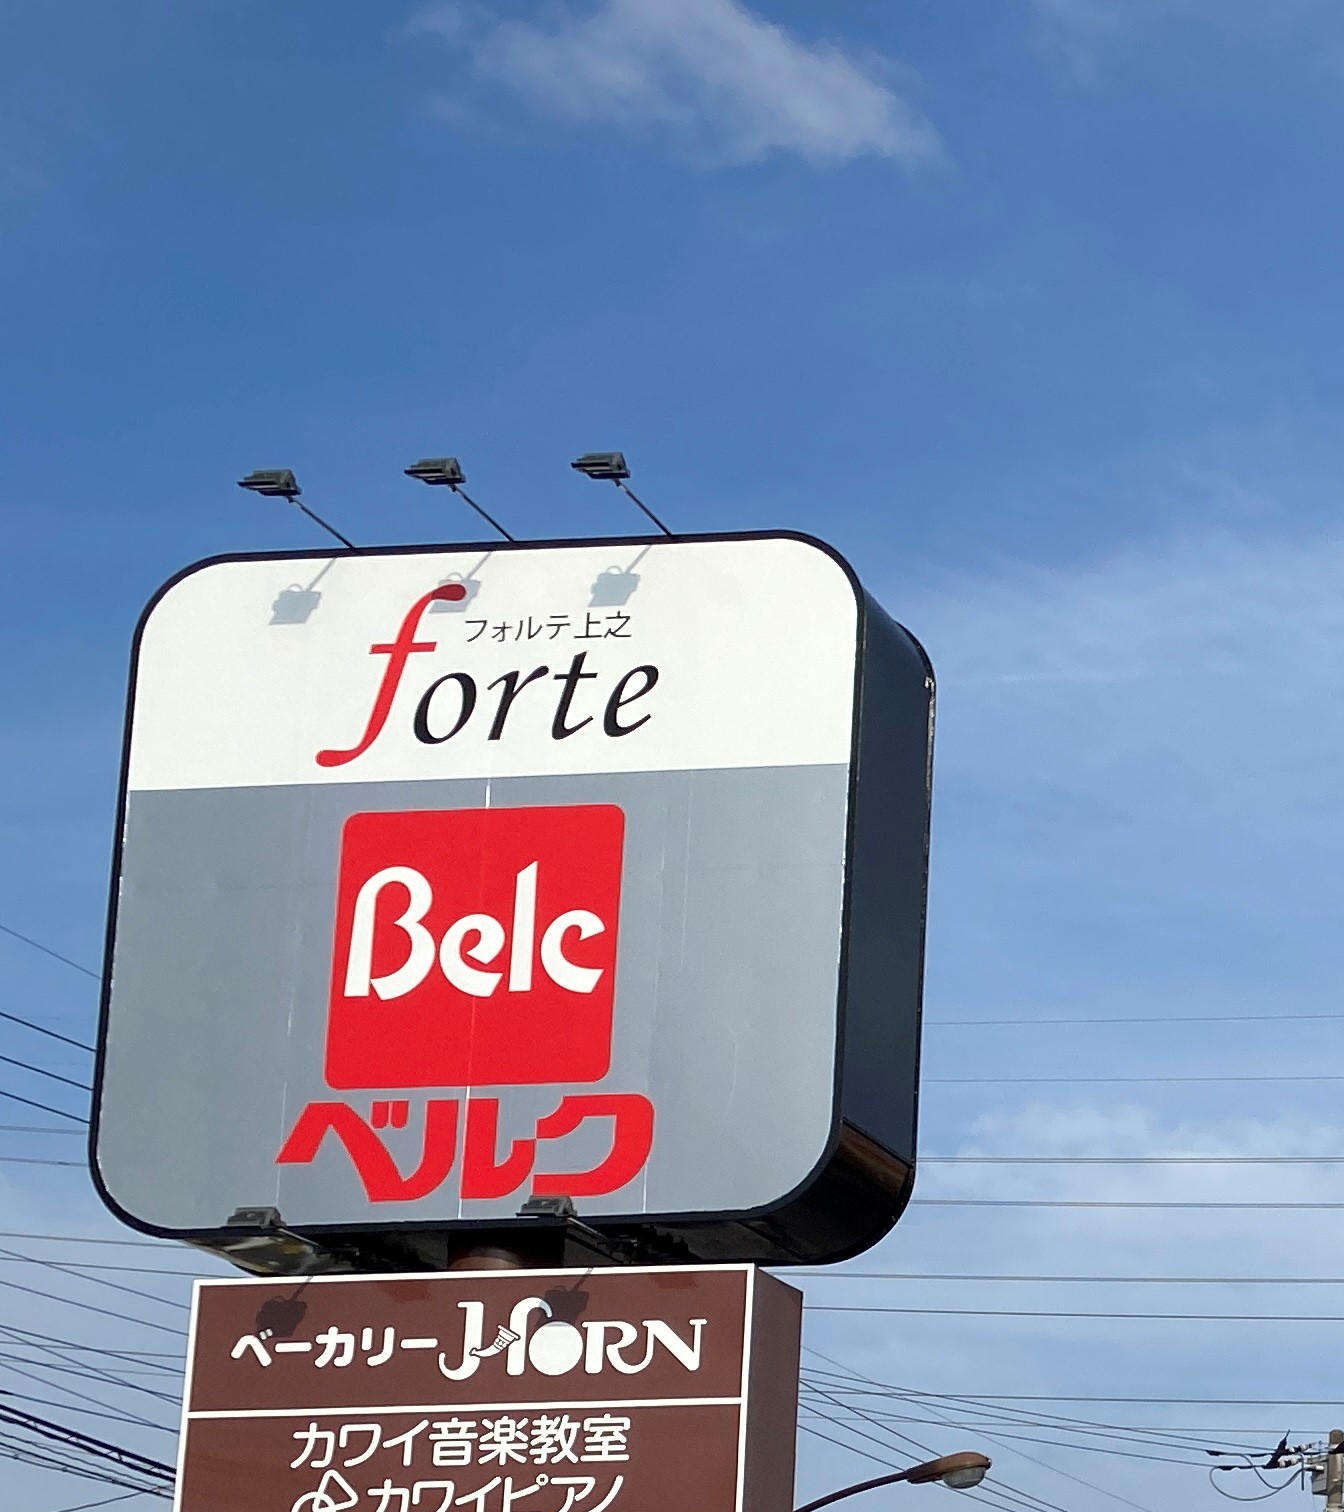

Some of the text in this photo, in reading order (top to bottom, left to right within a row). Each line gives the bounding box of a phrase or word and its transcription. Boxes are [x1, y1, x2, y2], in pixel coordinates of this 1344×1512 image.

[464, 610, 633, 644] フォルテ上之
[315, 582, 660, 769] forte
[343, 860, 607, 1001] Belc
[275, 1092, 655, 1203] ベルク
[230, 1326, 438, 1369] ベーカリー
[290, 1414, 631, 1469] カワイ音楽教室
